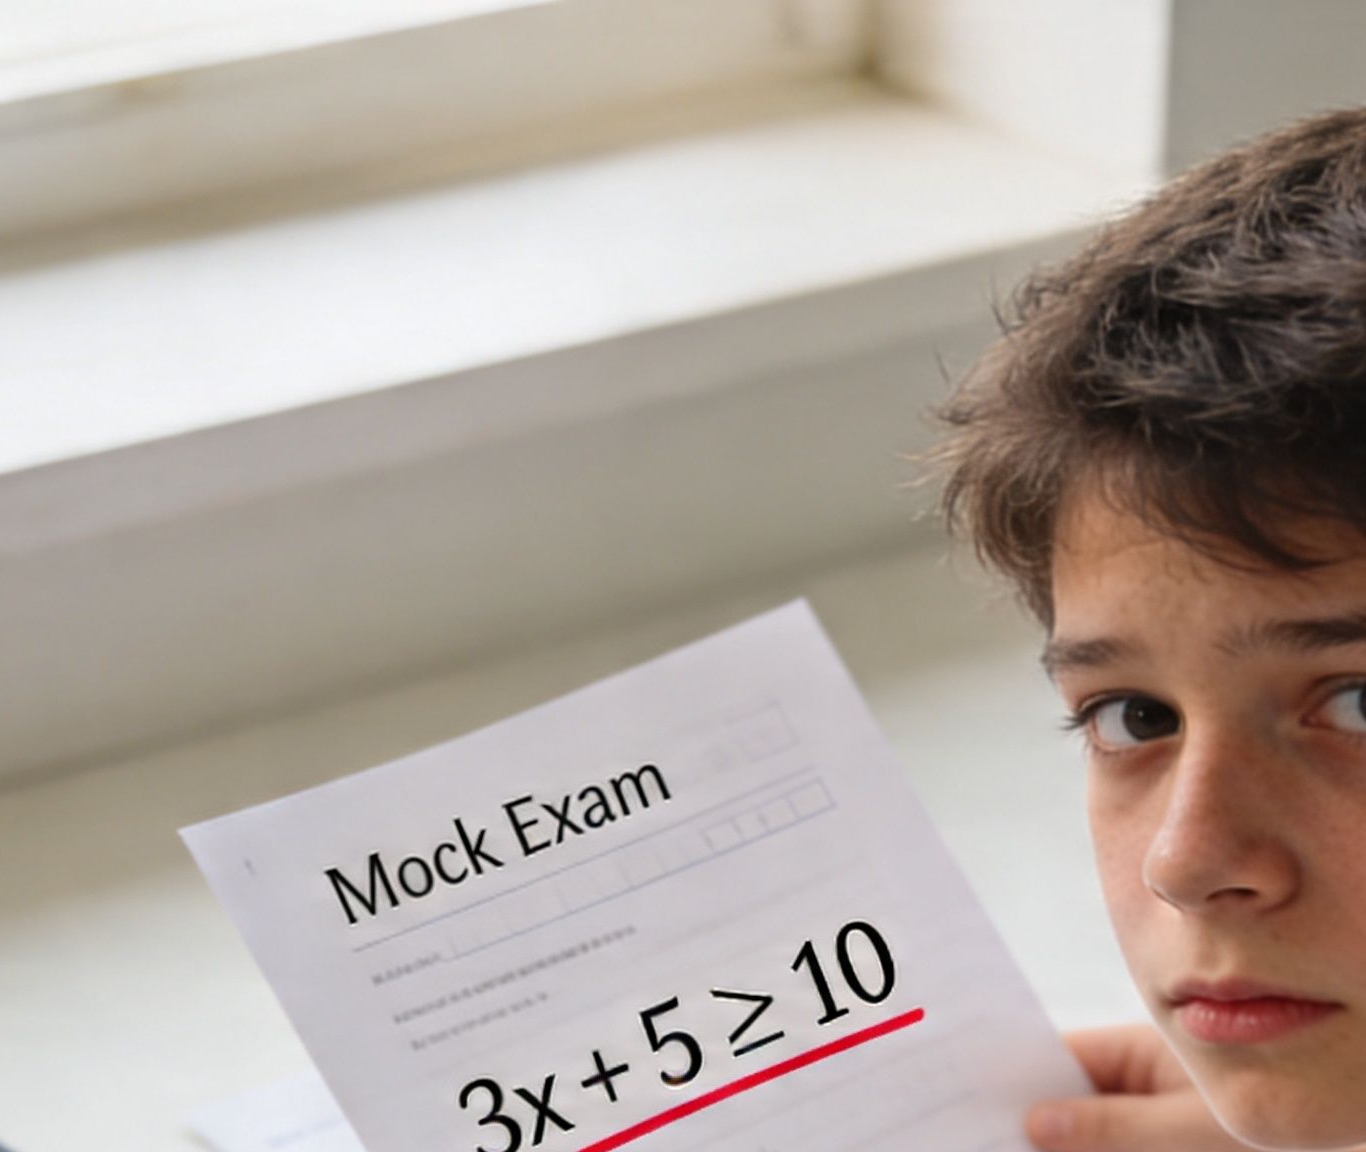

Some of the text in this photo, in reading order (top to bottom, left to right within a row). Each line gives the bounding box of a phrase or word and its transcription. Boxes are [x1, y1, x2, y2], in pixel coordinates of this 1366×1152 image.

[323, 763, 672, 926] Mock Exam
[580, 1049, 630, 1104] +
[638, 995, 704, 1086] 5
[709, 989, 786, 1058] ≥
[790, 920, 896, 1026] 10
